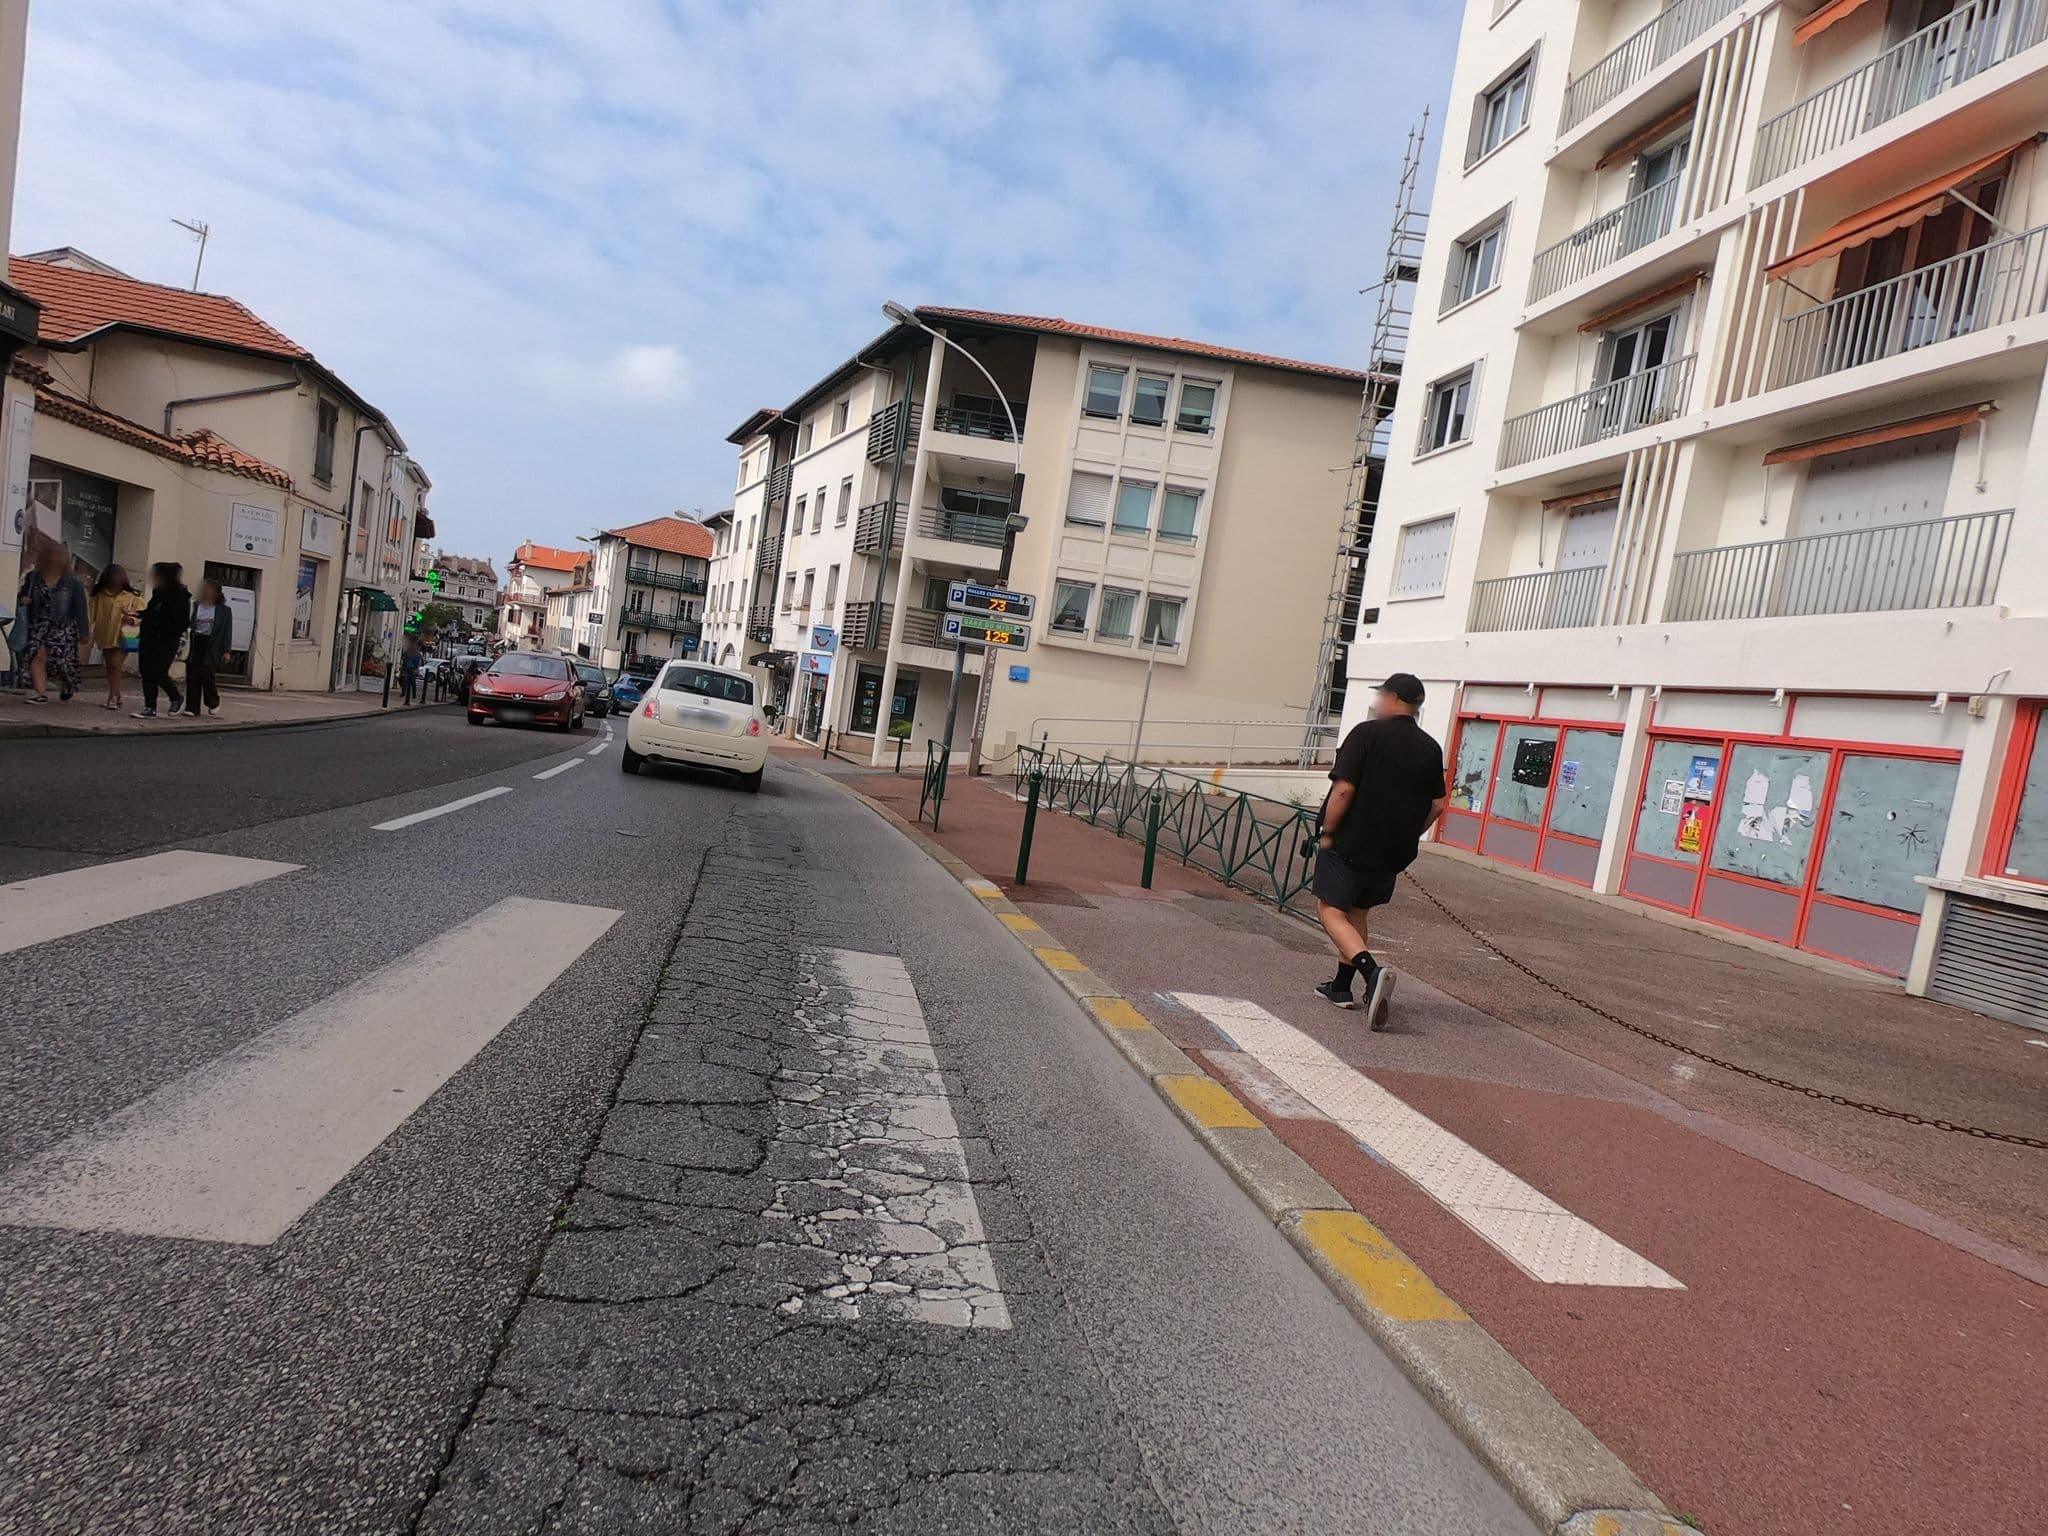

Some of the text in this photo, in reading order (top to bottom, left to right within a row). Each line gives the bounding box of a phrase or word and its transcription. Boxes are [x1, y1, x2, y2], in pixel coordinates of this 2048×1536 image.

[953, 591, 962, 601] P
[988, 598, 1007, 612] 73
[948, 621, 957, 632] P
[985, 630, 1010, 644] 125
